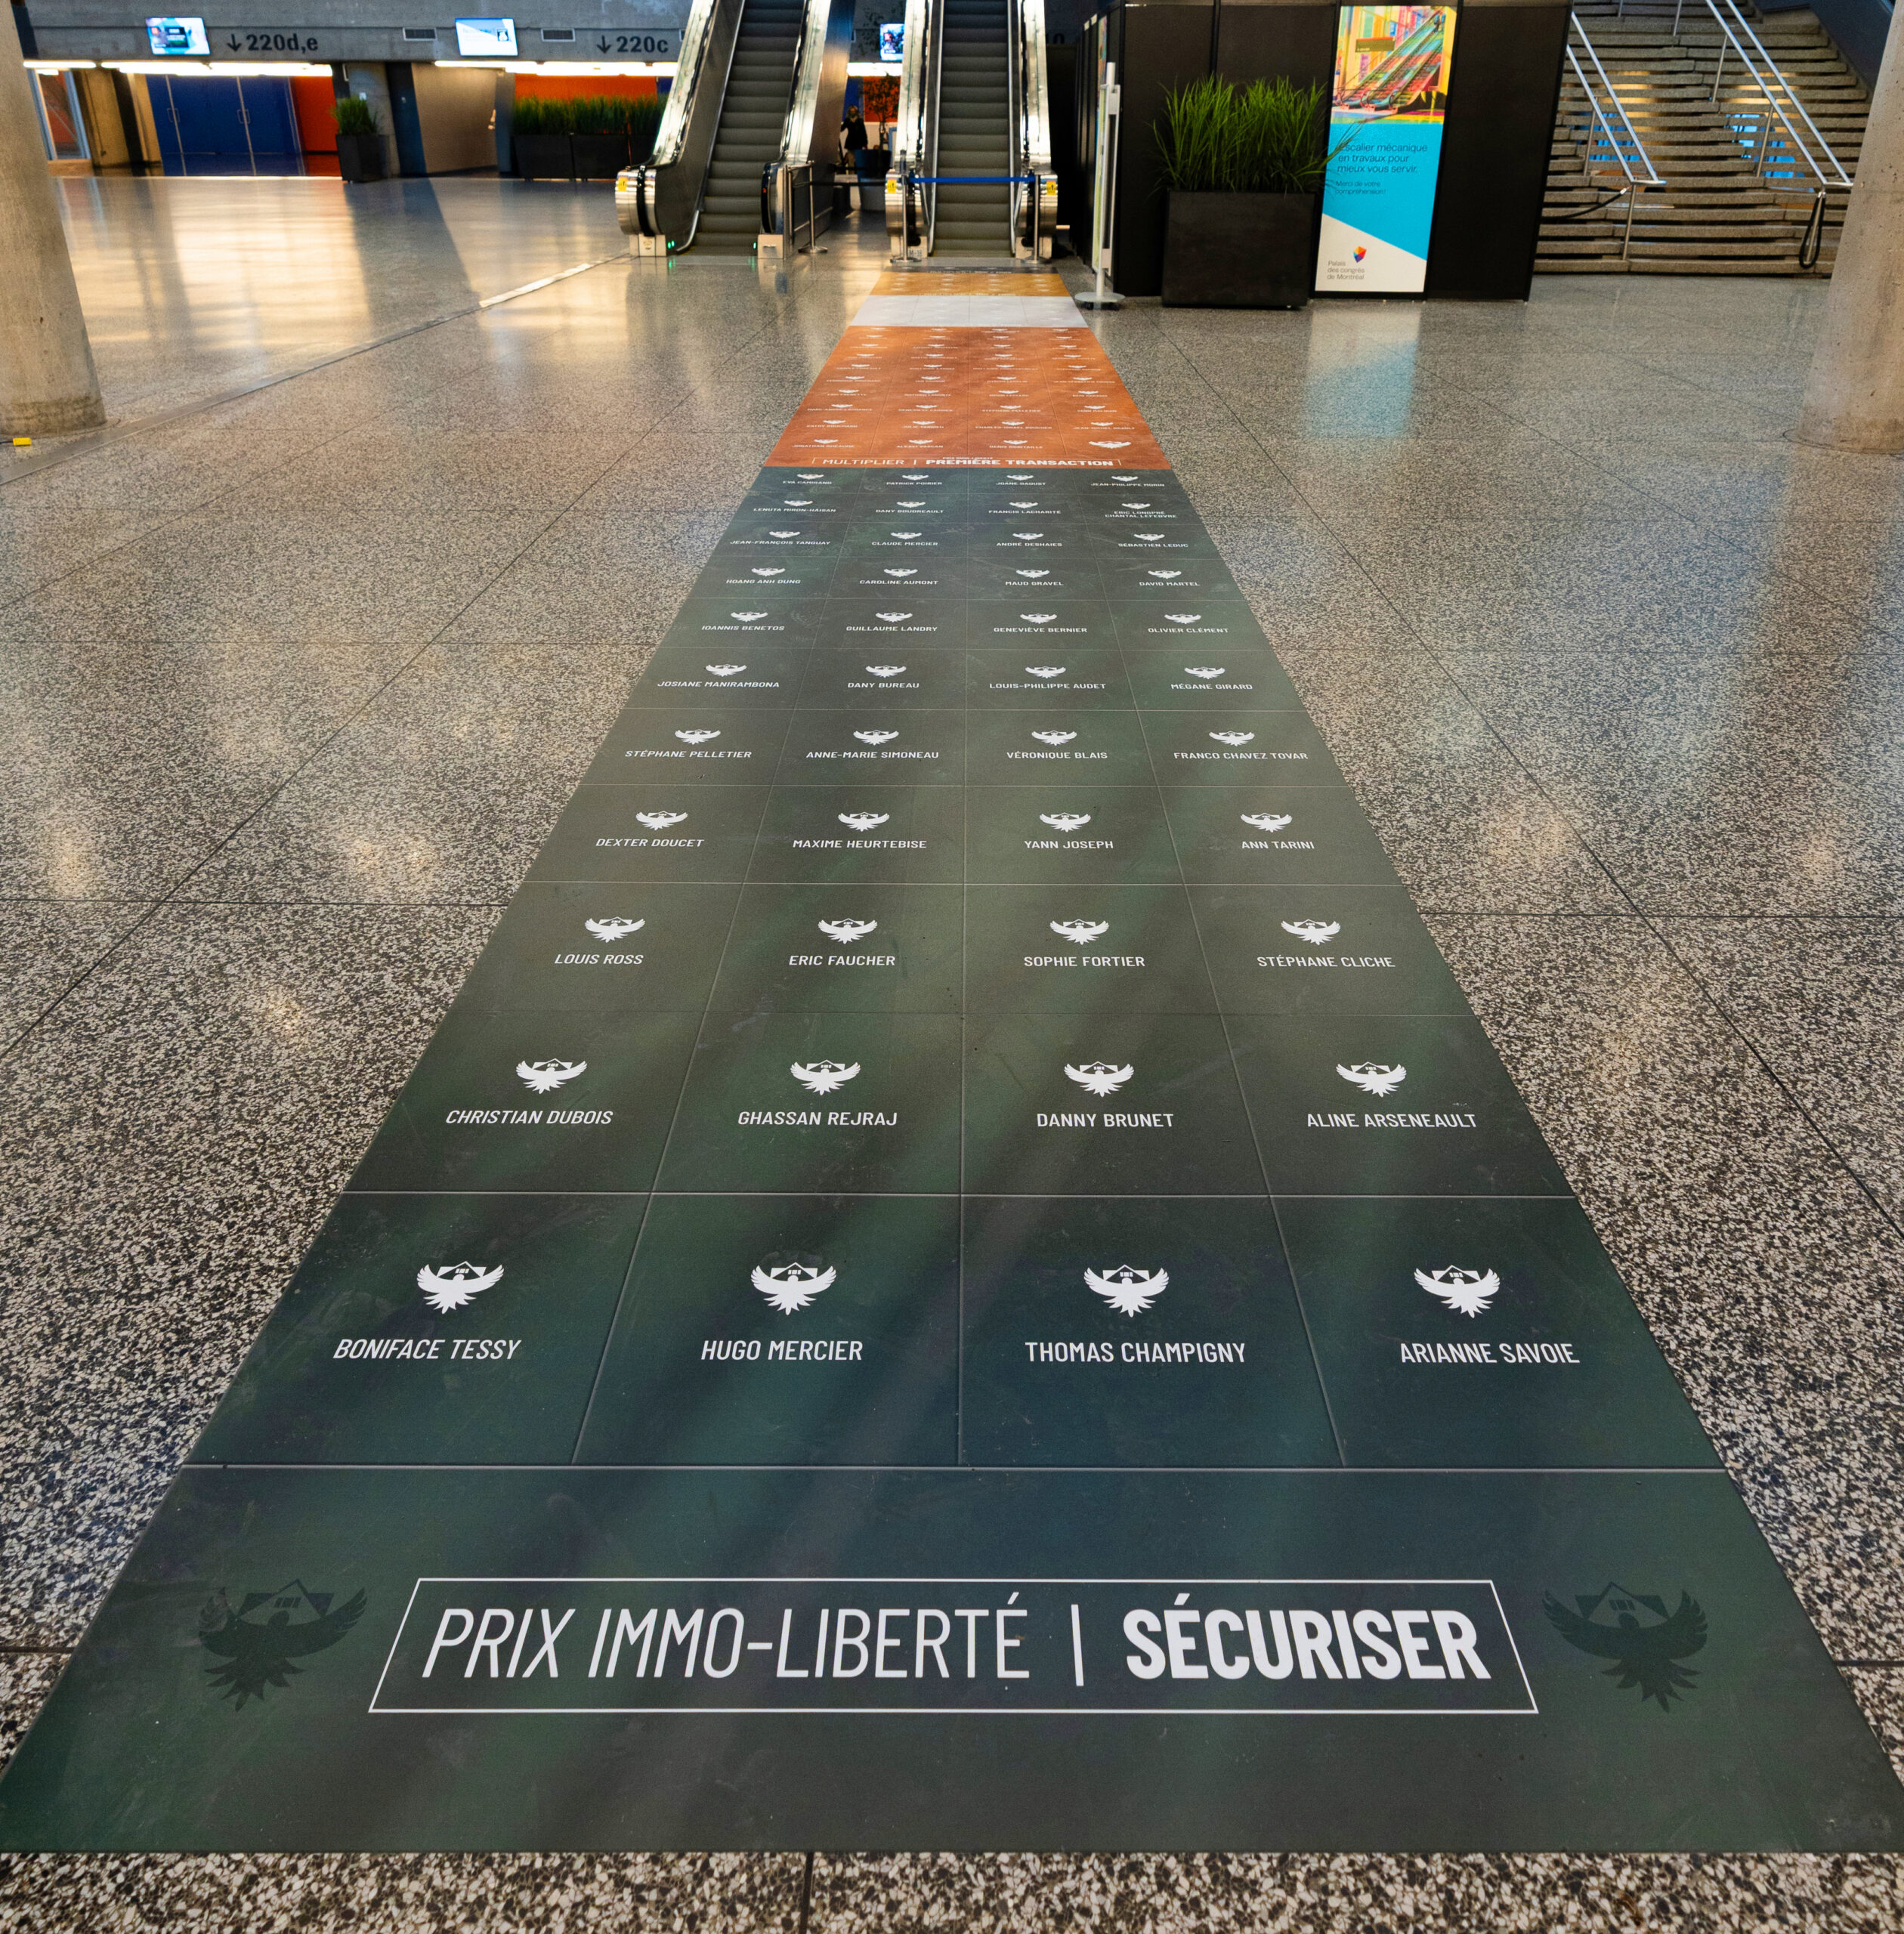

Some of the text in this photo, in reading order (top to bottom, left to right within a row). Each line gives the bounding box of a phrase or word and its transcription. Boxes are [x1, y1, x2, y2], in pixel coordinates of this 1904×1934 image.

[246, 35, 318, 54] 220d,e
[617, 36, 669, 53] 220c
[1377, 144, 1427, 153] mécanique
[1388, 156, 1409, 164] pour
[625, 749, 687, 757] STÉPHANE
[1006, 750, 1071, 760] VÉRONIQUE
[1173, 752, 1220, 760] FRANCO
[595, 839, 705, 848] DEXTER DOUCET
[793, 839, 927, 848] MAXIME HEURTEBISE
[1025, 840, 1114, 849] YANN JOSEPH
[1241, 841, 1315, 850] ANN TARINI
[555, 954, 644, 965] LOUIS ROSS
[789, 955, 895, 966] ERIC FAUCHER
[1024, 956, 1145, 967] SOPHIE FORTIER
[1257, 954, 1396, 968] STÉPHANE CLICHE
[446, 1110, 613, 1125] CHRISTIAN DUBOIS
[738, 1111, 897, 1126] GHASSAN REJRAJ
[1037, 1114, 1174, 1127] DANNY BRUNET
[1307, 1114, 1478, 1128] ALINE ARSENEAULT
[333, 1338, 521, 1361] BONIFACE TESSY
[701, 1339, 862, 1361] HUGO MERCIER
[1025, 1341, 1246, 1364] THOMAS CHAMPIGNY
[1399, 1342, 1580, 1364] ARIANNE SAVOIE
[422, 1592, 1493, 1681] PRIX IMMO-LIBERTÉ SÉCURISER
